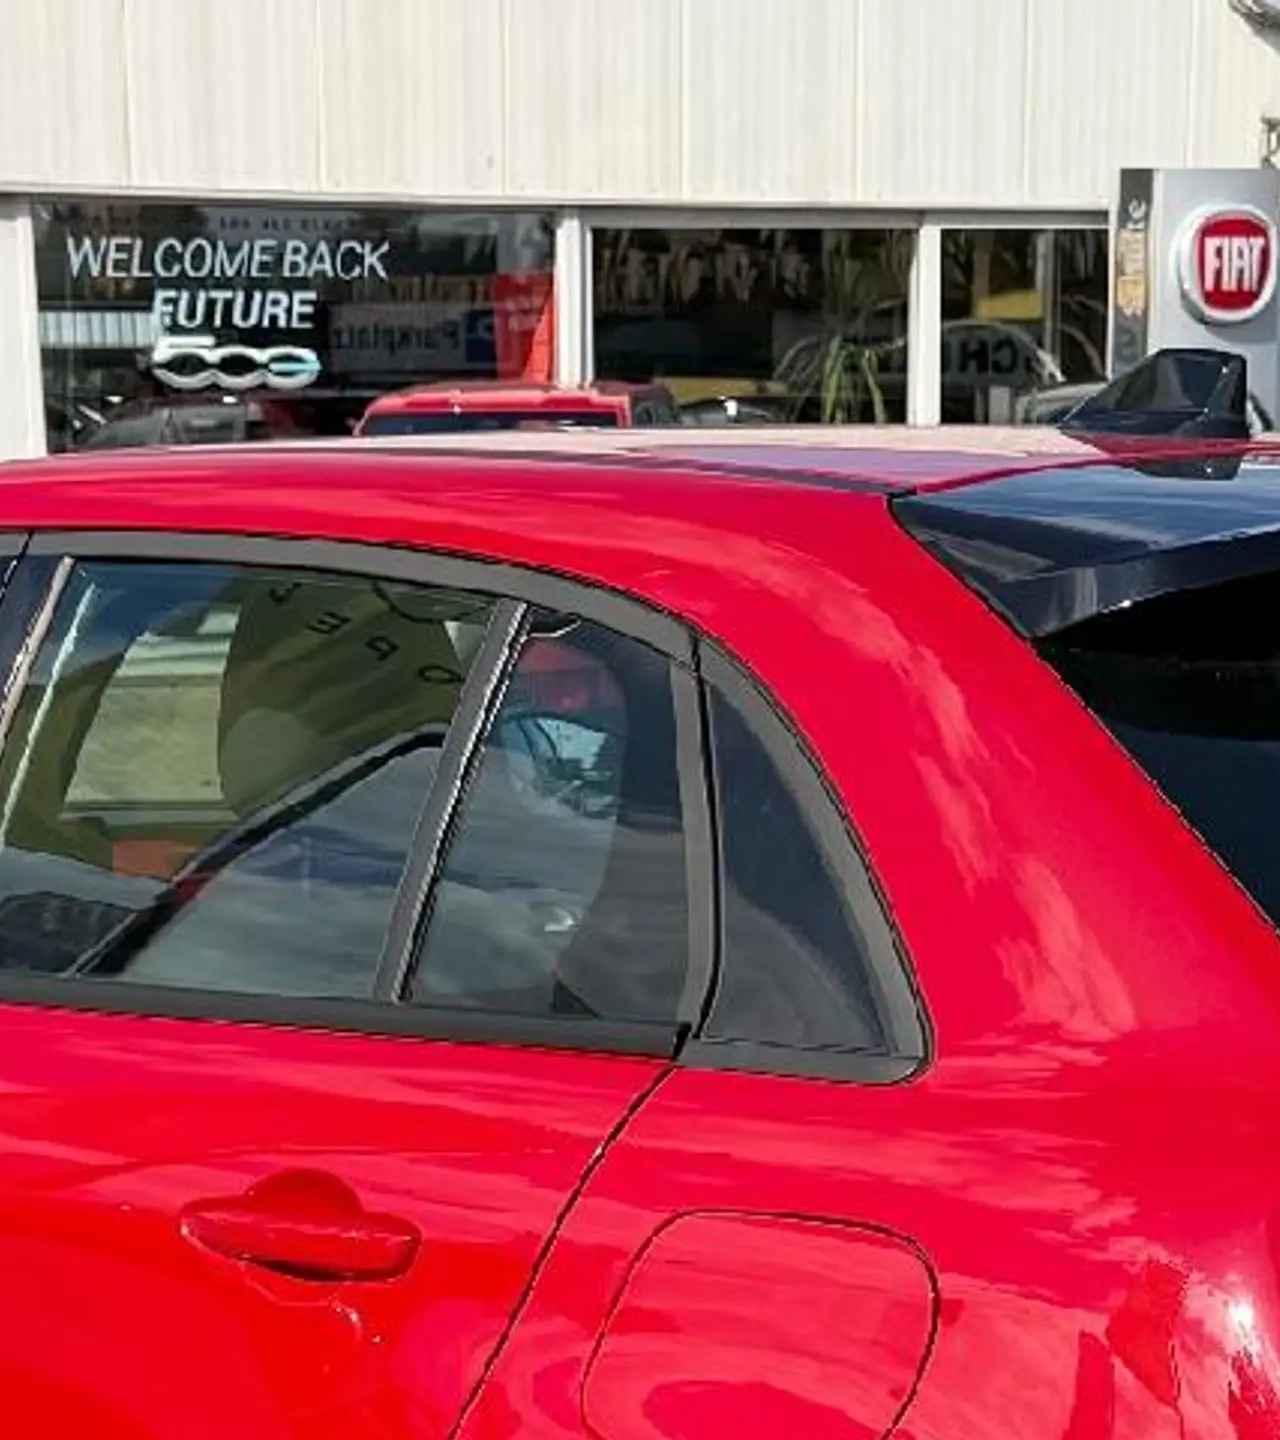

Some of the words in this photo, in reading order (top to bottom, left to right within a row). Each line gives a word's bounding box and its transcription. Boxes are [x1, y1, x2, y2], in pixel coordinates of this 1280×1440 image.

[66, 237, 278, 279] WELCOME
[281, 240, 389, 281] BACK
[1204, 236, 1266, 292] FIAT
[153, 289, 318, 329] FUTURE
